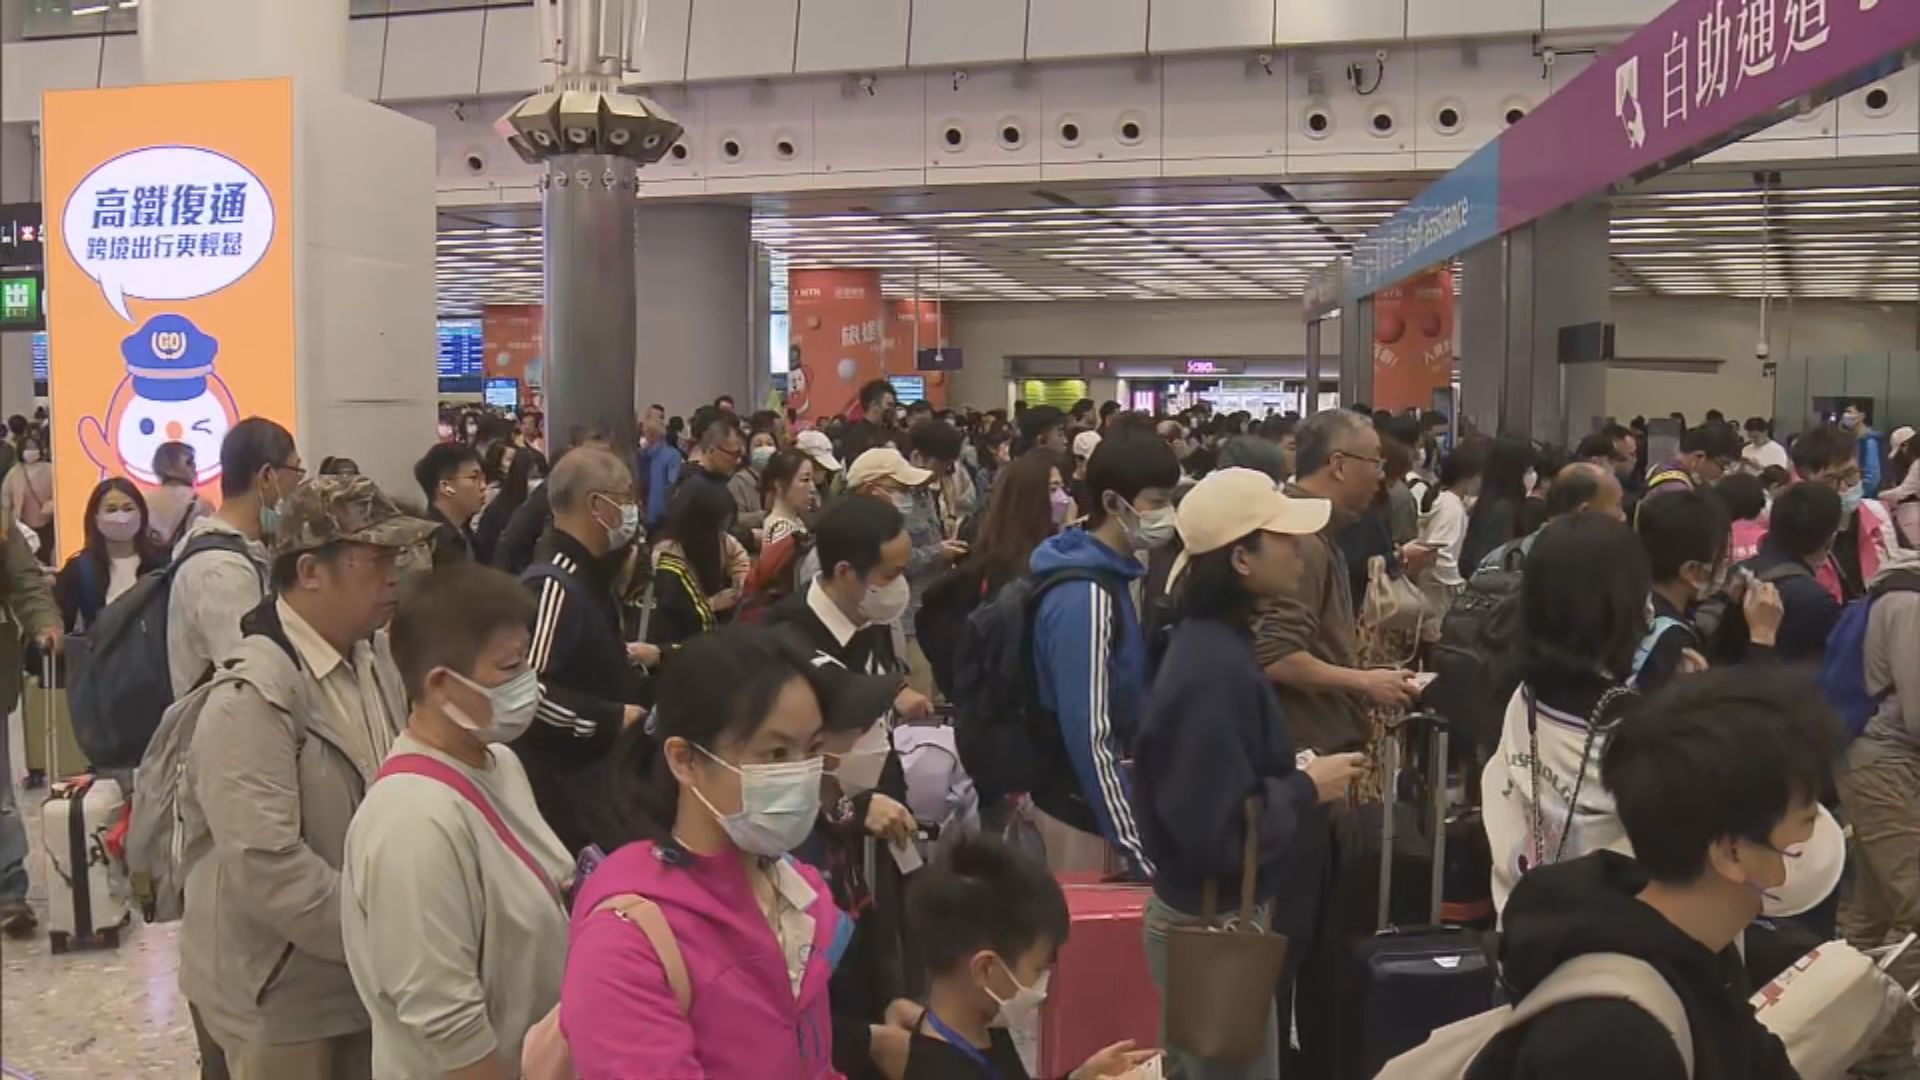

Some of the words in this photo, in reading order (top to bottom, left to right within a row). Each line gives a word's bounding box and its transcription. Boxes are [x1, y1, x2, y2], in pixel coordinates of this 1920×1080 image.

[1662, 0, 1831, 128] 自助通道
[92, 182, 248, 229] 高鐵復通
[87, 232, 243, 260] 跨境出行更輕鬆
